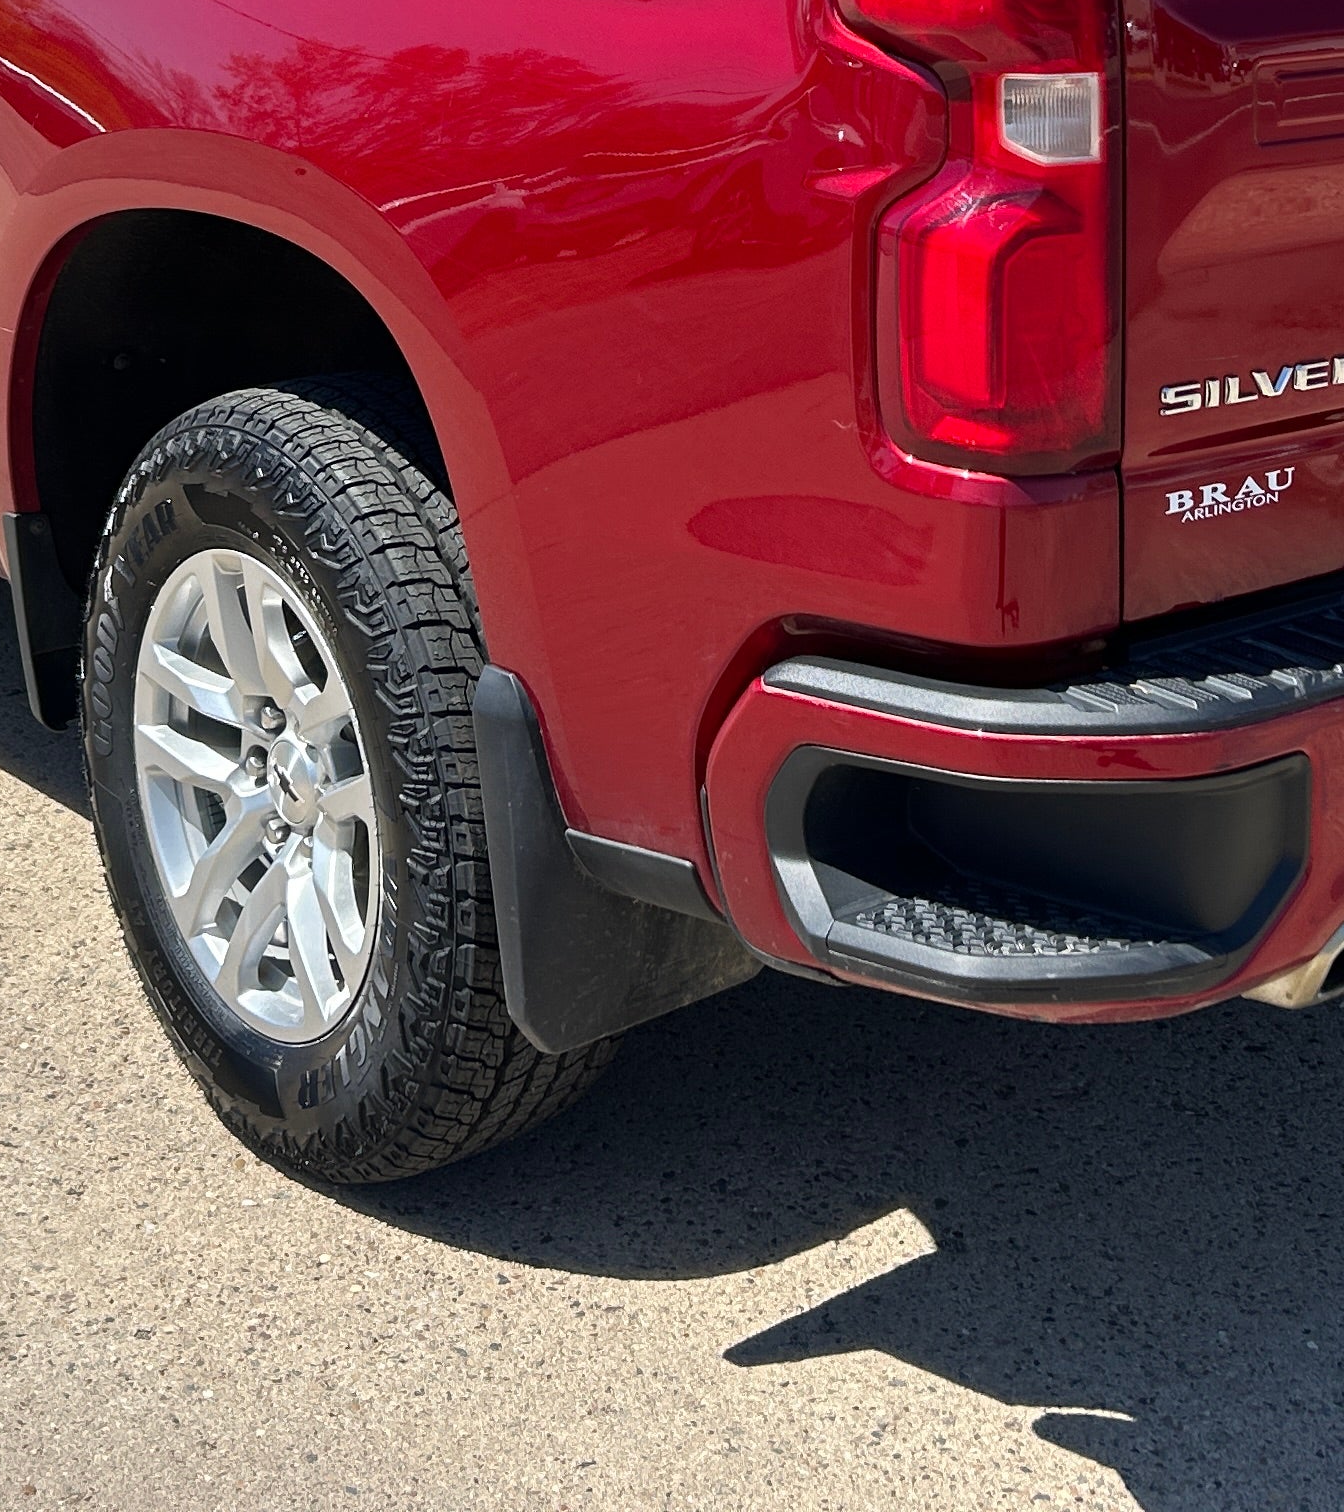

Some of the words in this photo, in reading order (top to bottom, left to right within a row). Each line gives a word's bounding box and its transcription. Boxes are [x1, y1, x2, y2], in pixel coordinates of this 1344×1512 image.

[1164, 466, 1296, 516] BRAU
[1181, 491, 1280, 524] ARLINGTON
[92, 497, 179, 757] GOODYEAR
[145, 948, 224, 1068] TERRITORY
